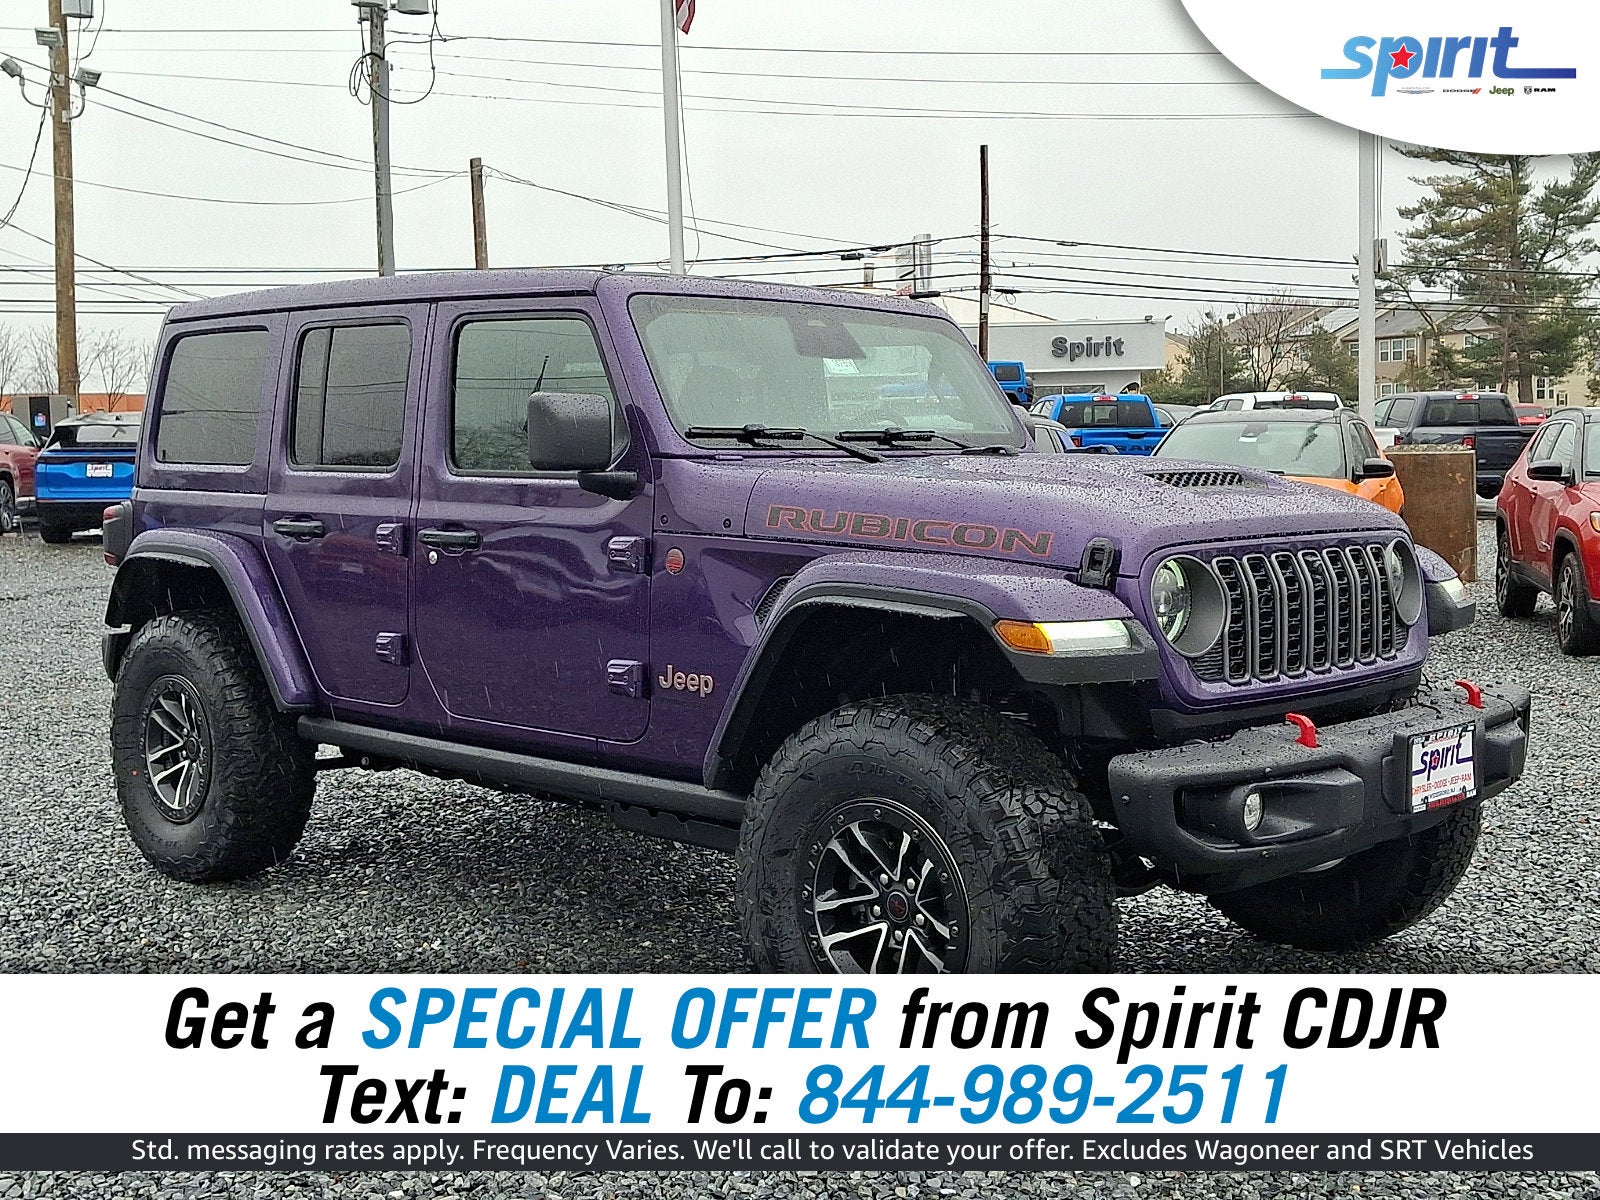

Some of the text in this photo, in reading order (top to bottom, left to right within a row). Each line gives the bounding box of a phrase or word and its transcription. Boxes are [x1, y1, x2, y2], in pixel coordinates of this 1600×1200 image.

[1051, 336, 1124, 361] Spirit
[766, 504, 1055, 558] RUBICON
[658, 664, 714, 698] Jeep
